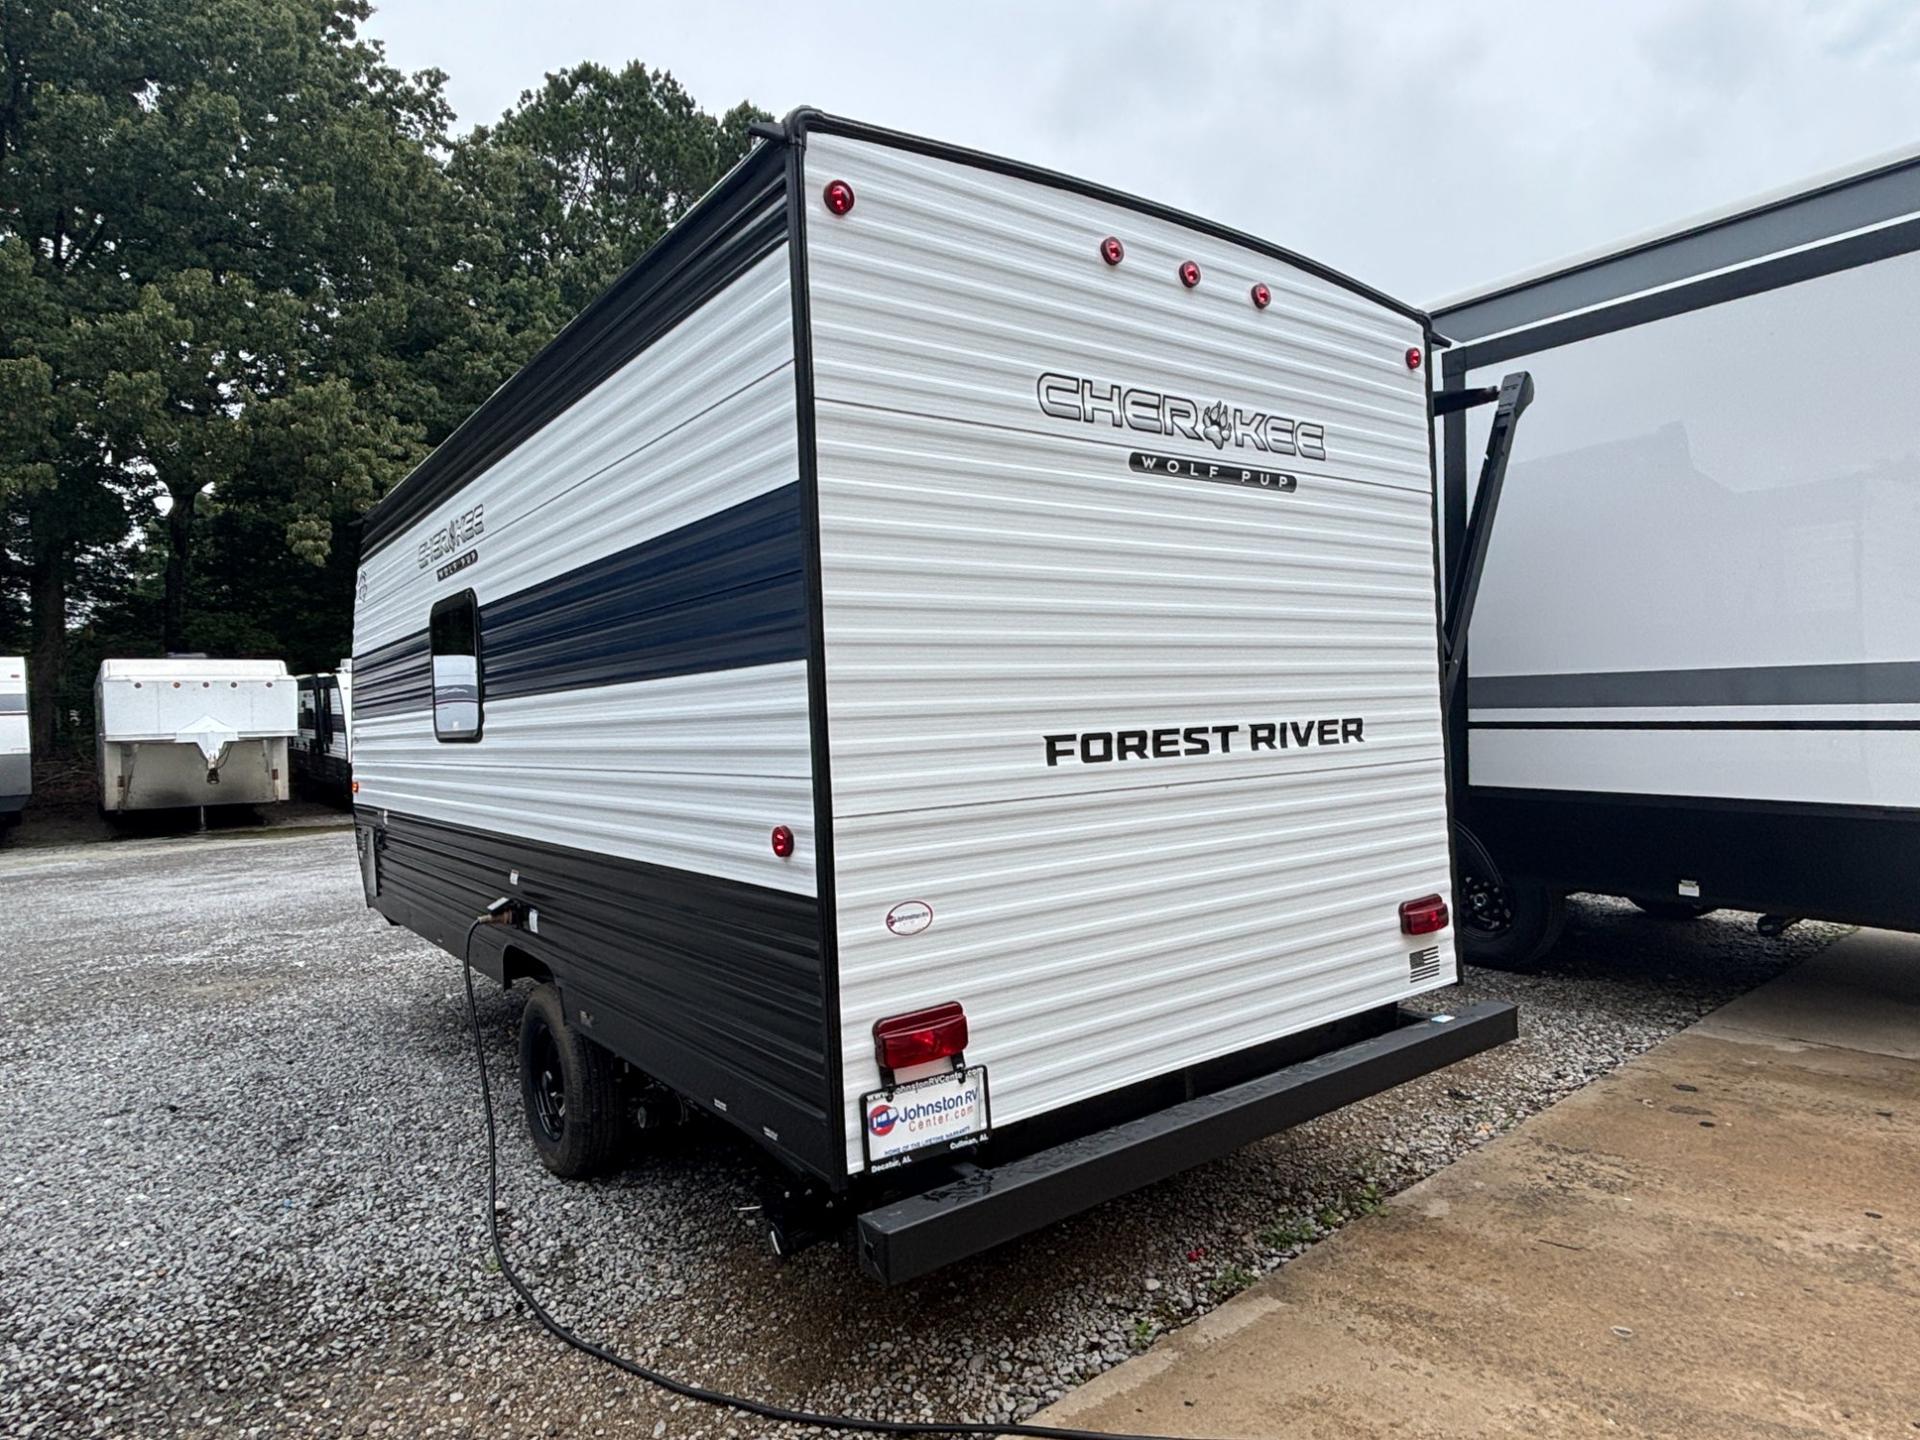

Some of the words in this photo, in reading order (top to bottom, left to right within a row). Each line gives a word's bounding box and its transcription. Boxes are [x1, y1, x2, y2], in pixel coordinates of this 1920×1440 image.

[1140, 456, 1219, 478] WOLF
[1241, 472, 1288, 488] PUP
[1043, 725, 1239, 766] FOREST
[1249, 718, 1365, 751] RIVER
[900, 1096, 963, 1123] Johnston
[965, 1087, 979, 1104] RV
